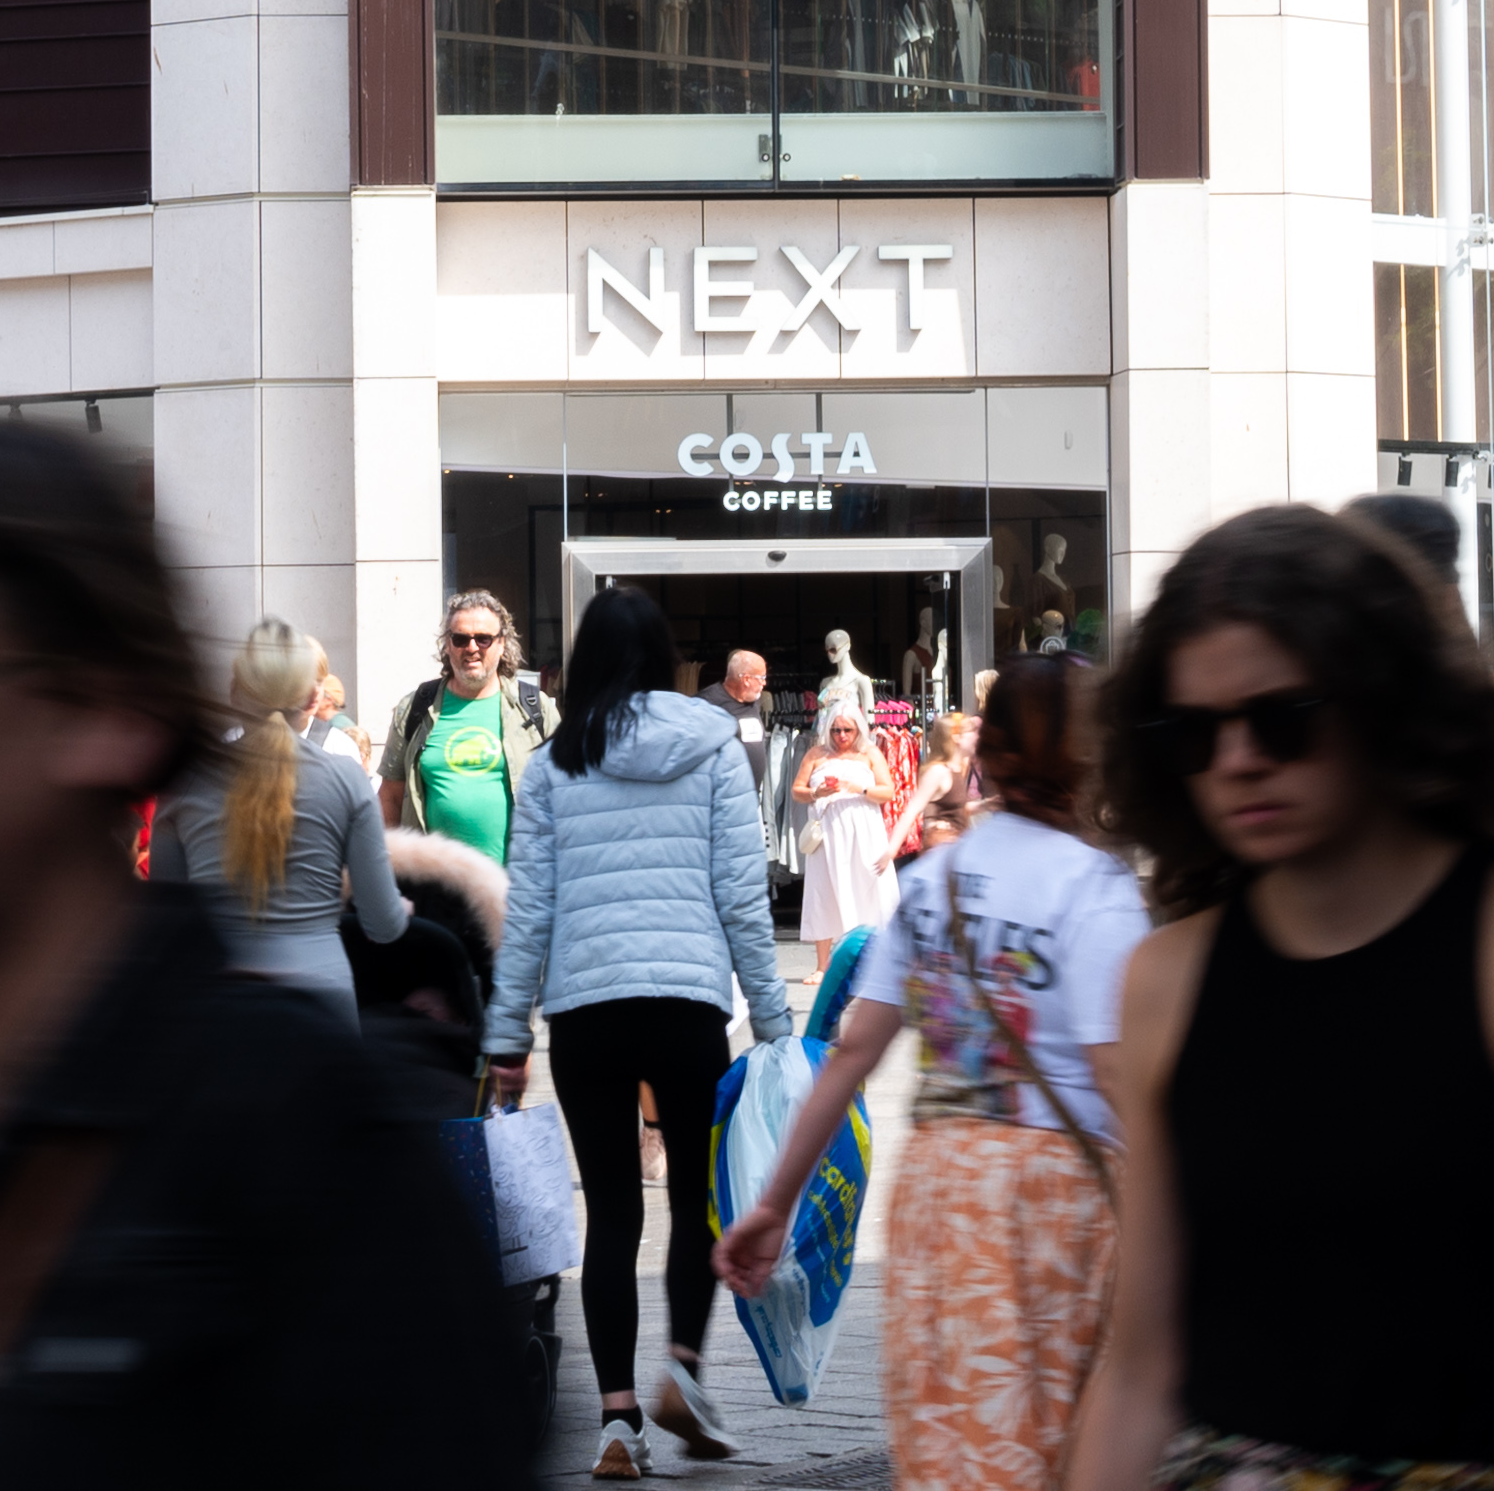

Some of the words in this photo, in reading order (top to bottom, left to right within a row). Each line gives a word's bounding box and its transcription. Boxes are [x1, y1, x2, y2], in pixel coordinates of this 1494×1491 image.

[587, 245, 954, 335] NEXT
[677, 431, 878, 483] COSTA
[723, 490, 833, 512] COFFEE
